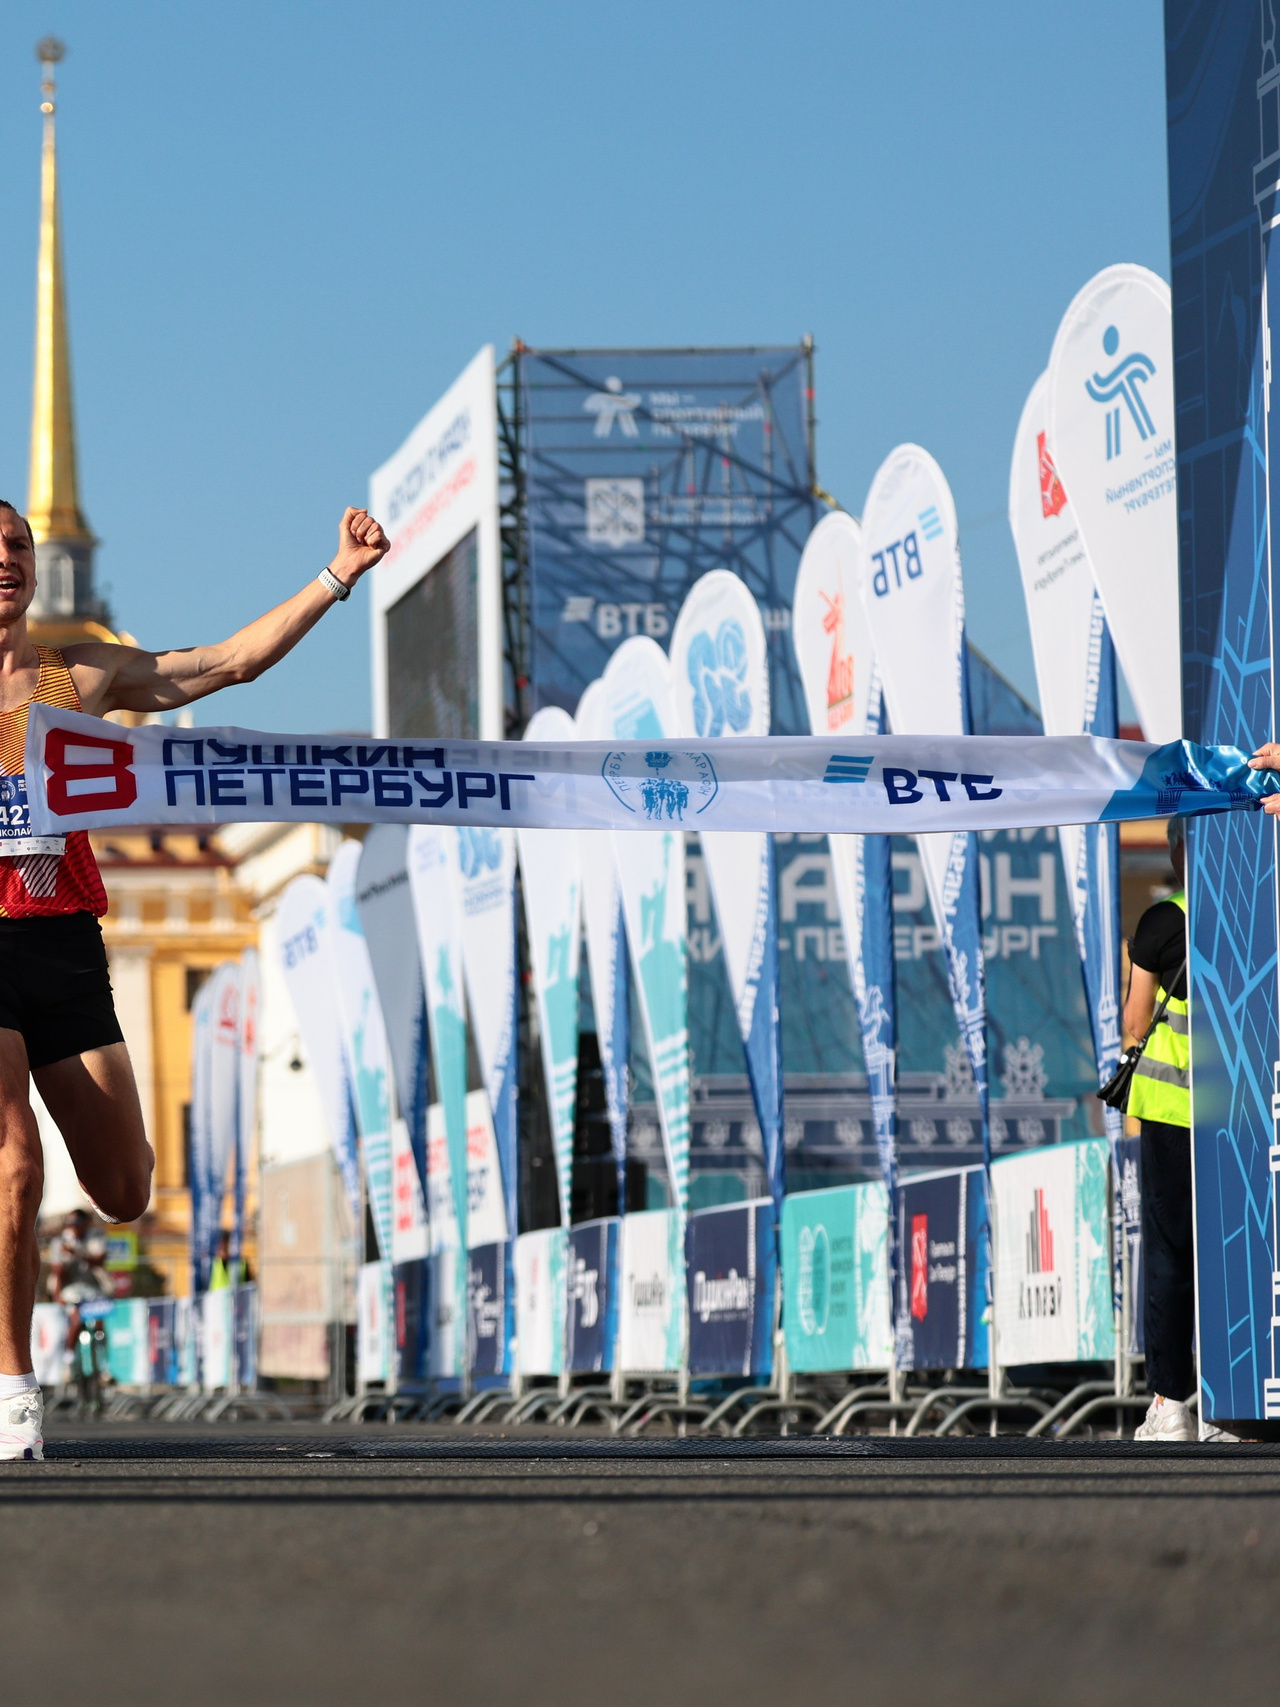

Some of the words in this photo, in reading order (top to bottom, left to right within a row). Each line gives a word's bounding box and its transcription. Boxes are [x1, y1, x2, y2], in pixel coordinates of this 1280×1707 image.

[596, 603, 669, 638] ВТБ
[44, 727, 138, 816] 8
[162, 738, 446, 769] ПУШКИН
[164, 768, 536, 810] ПЕТЕРБУРГ
[882, 767, 1003, 805] ВТБ
